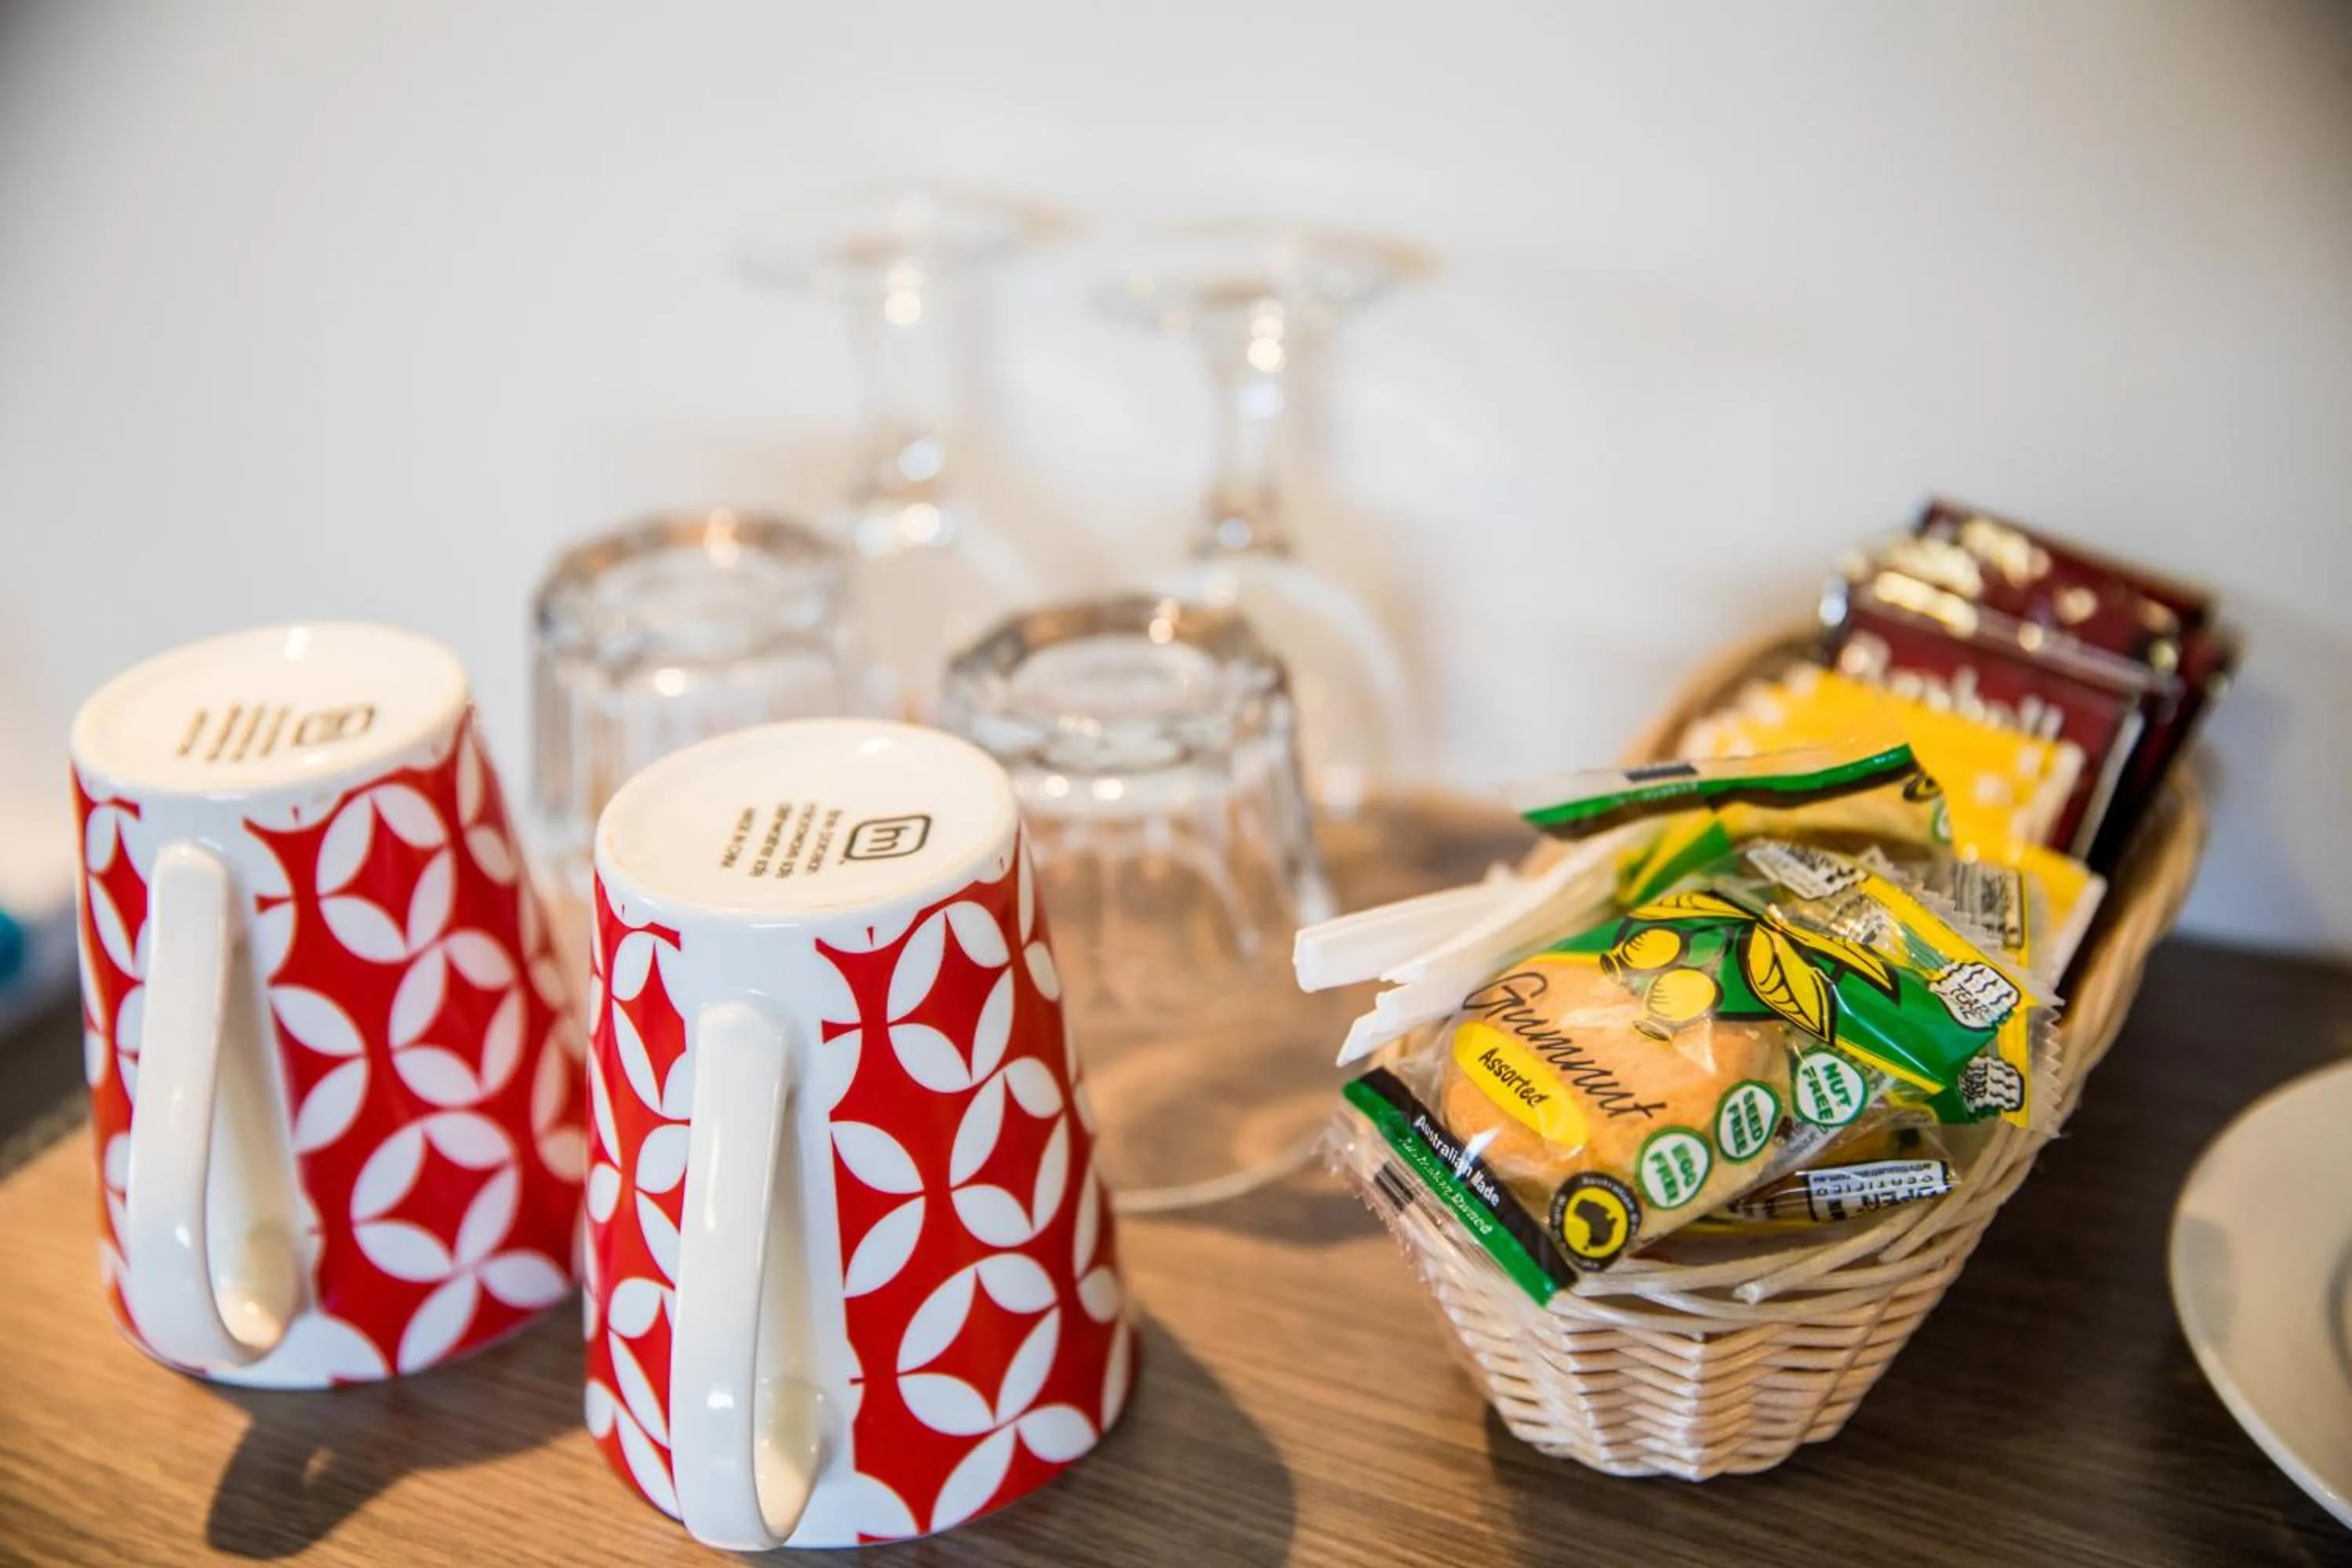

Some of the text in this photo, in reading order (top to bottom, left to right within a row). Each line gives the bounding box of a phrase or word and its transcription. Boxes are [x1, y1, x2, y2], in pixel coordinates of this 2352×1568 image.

[1461, 971, 1668, 1120] Gumnut
[1478, 1047, 1550, 1109] Assorted
[1801, 1065, 1835, 1122] FREE
[1821, 1062, 1853, 1109] NUT
[1726, 1102, 1749, 1156] FREE
[1742, 1090, 1765, 1142] SEED
[1399, 1136, 1494, 1236] Australian Owned
[1414, 1114, 1501, 1208] Australian Made
[1649, 1150, 1680, 1204] FREE
[1670, 1142, 1697, 1189] EGG
